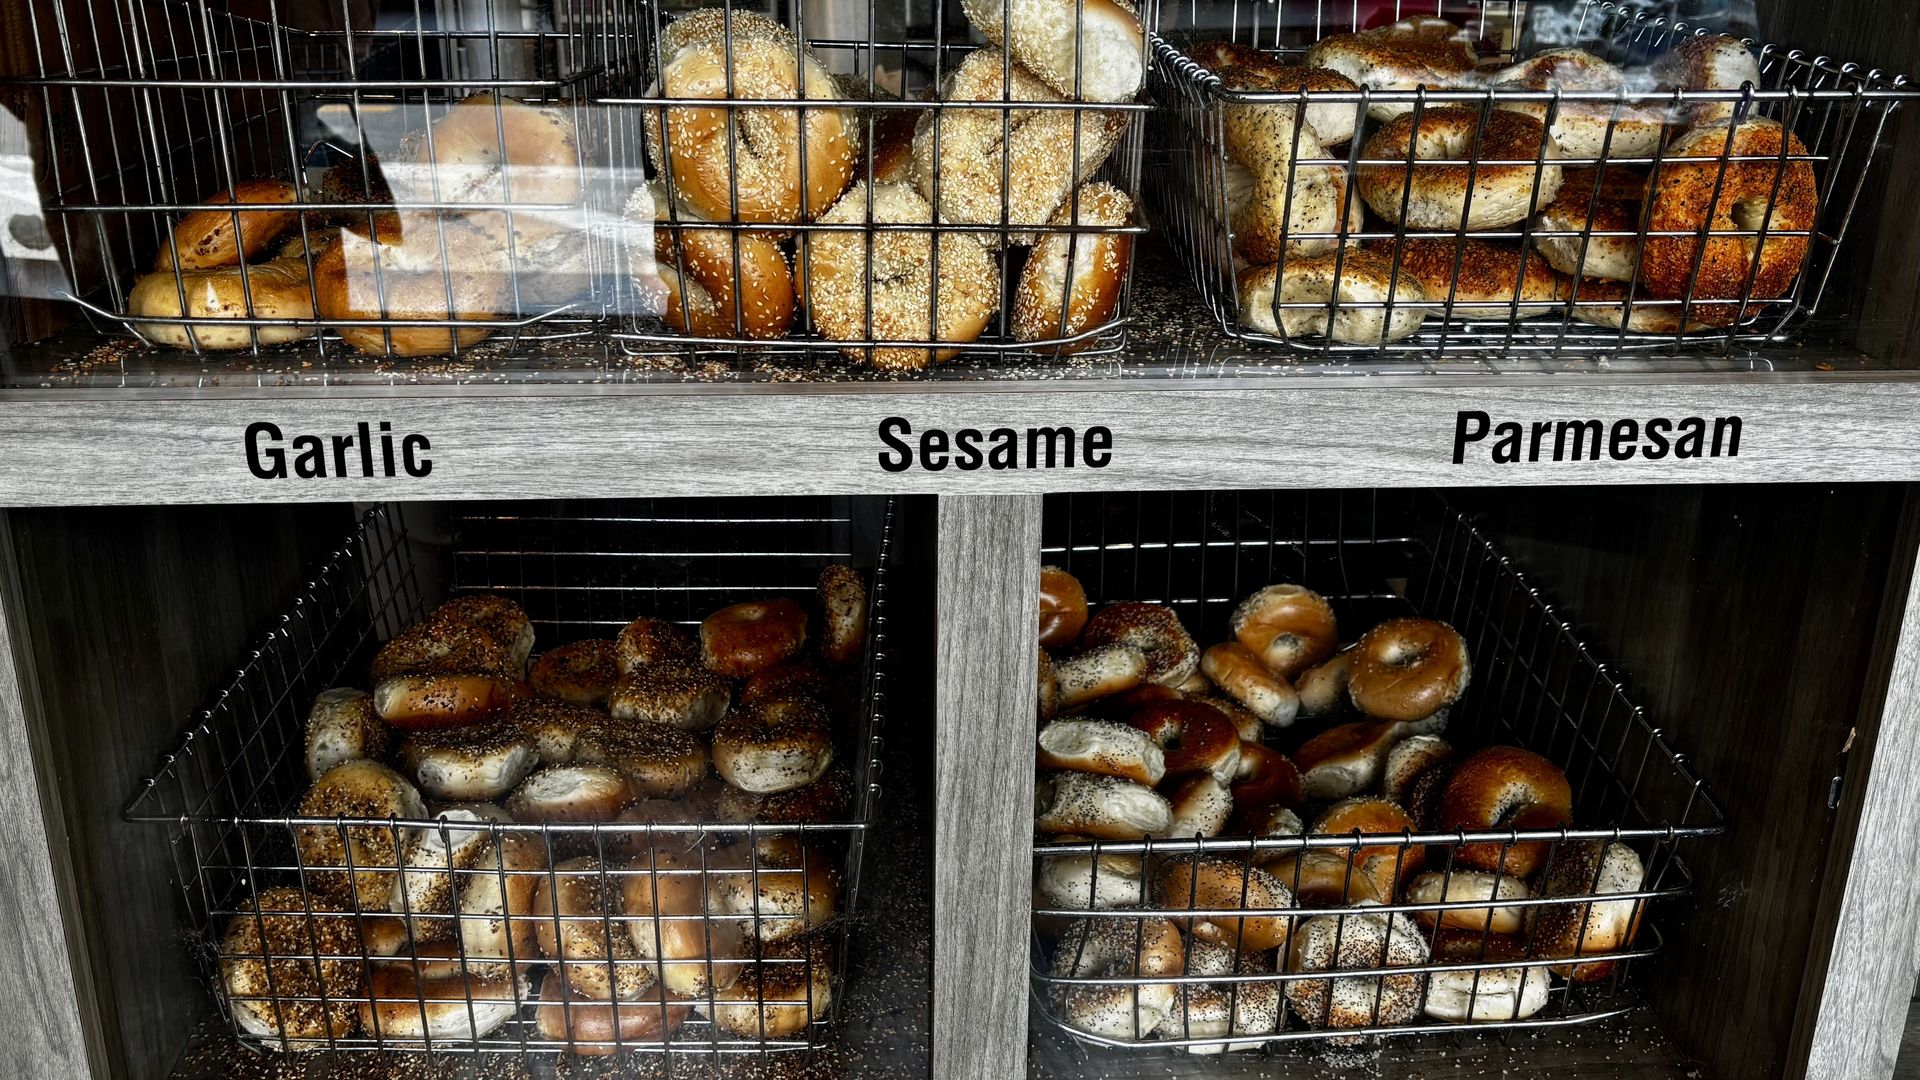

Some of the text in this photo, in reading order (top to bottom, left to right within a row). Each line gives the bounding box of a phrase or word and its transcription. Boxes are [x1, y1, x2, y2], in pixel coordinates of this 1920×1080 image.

[244, 421, 433, 480] Garlic
[878, 416, 1113, 473] Sesame
[1452, 411, 1743, 465] Parmesan
